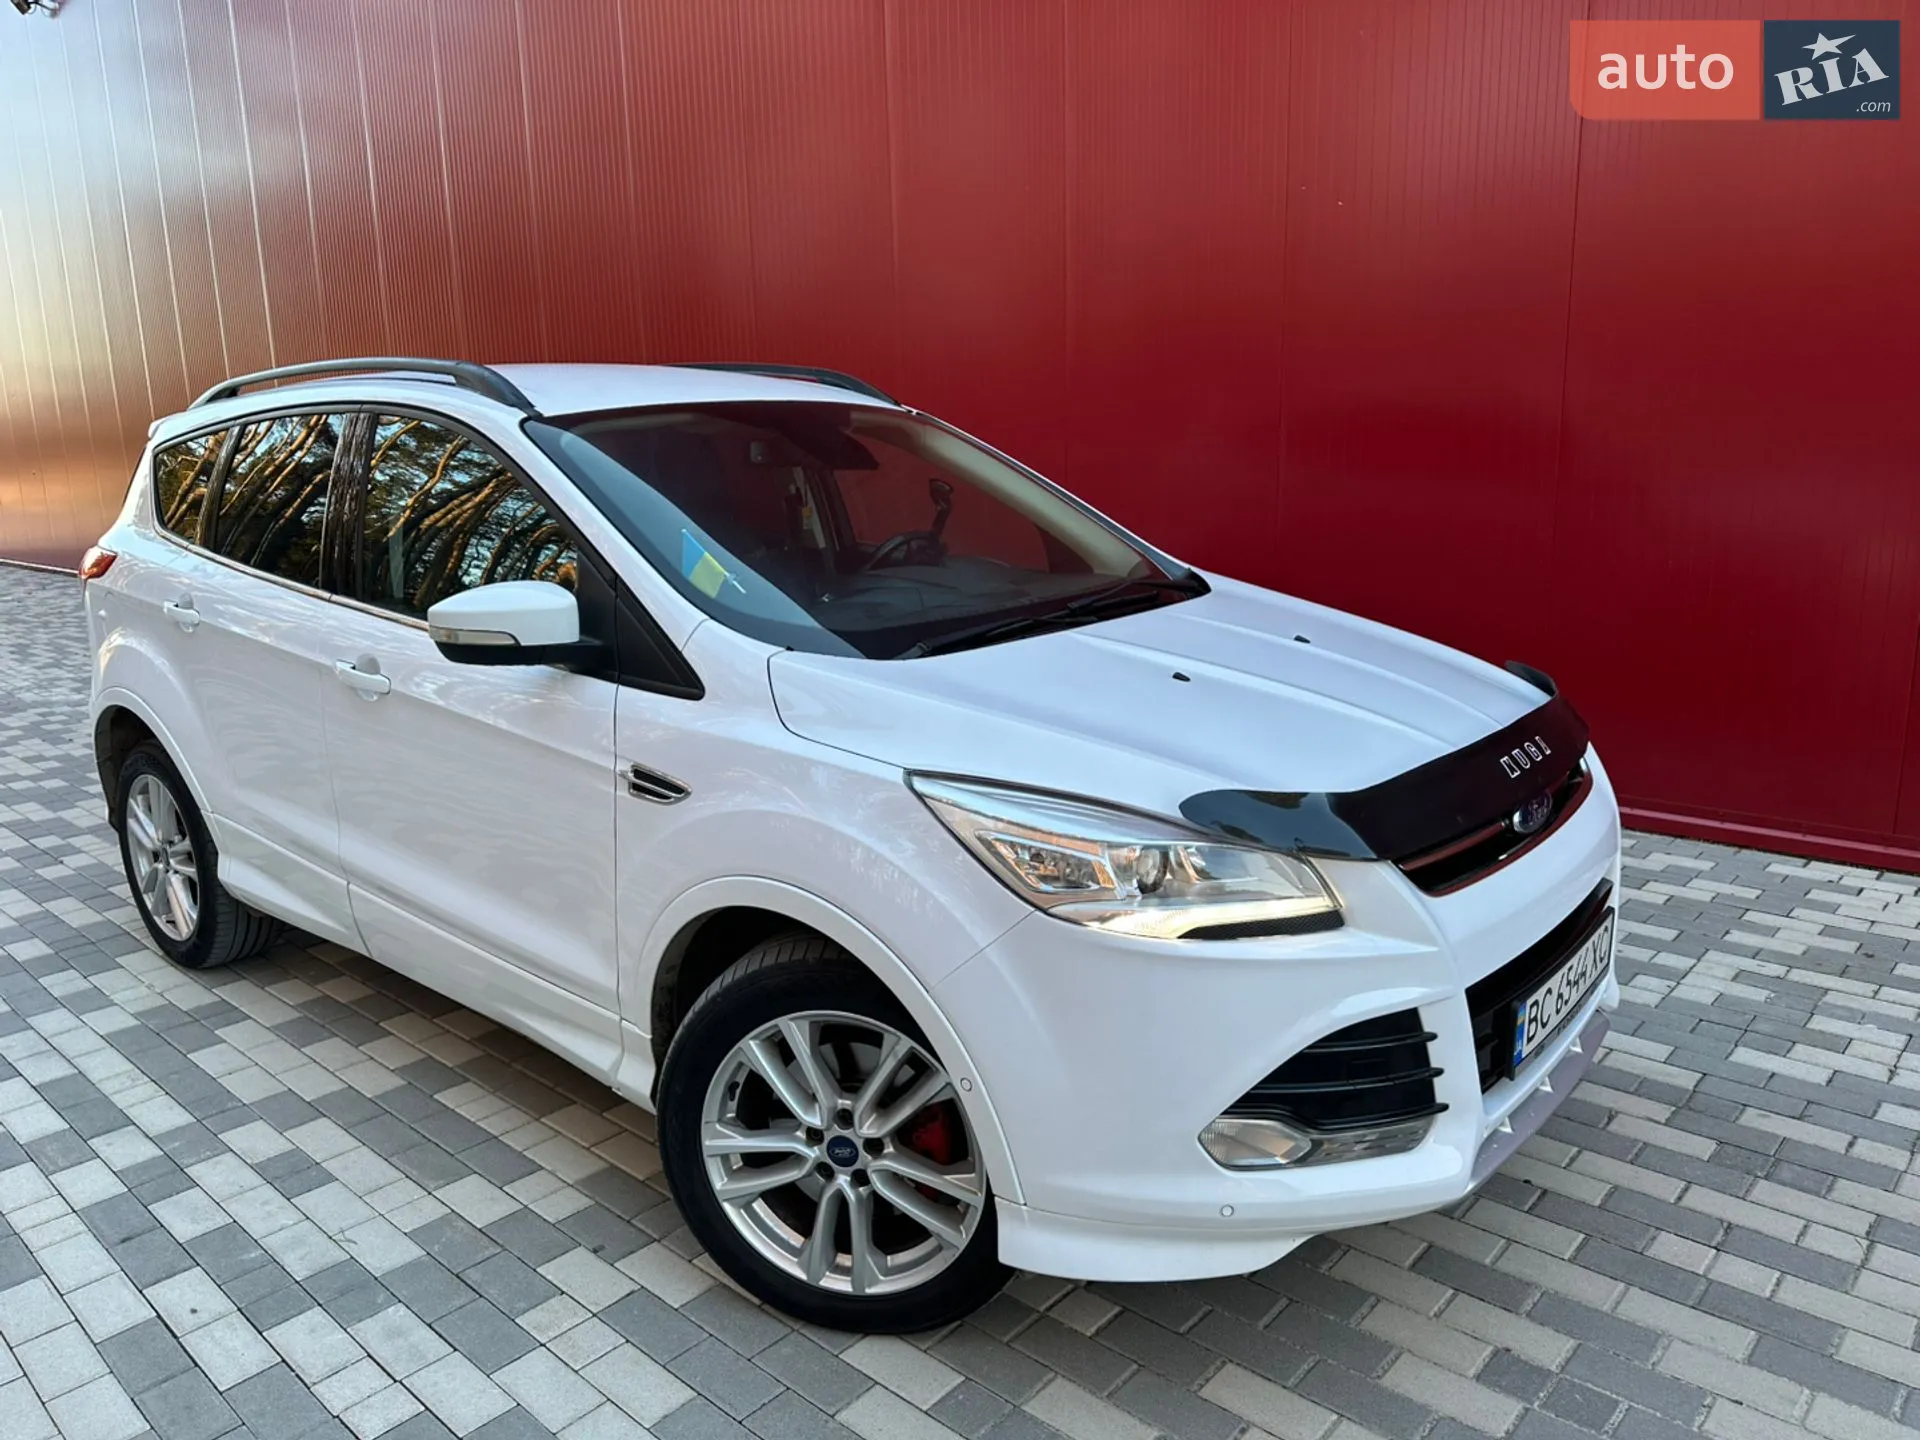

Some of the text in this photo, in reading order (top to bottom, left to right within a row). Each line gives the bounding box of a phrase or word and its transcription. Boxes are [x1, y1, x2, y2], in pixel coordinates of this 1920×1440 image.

[1526, 987, 1553, 1046] BC
[1554, 947, 1590, 1016] 6544
[1589, 924, 1609, 978] XC
